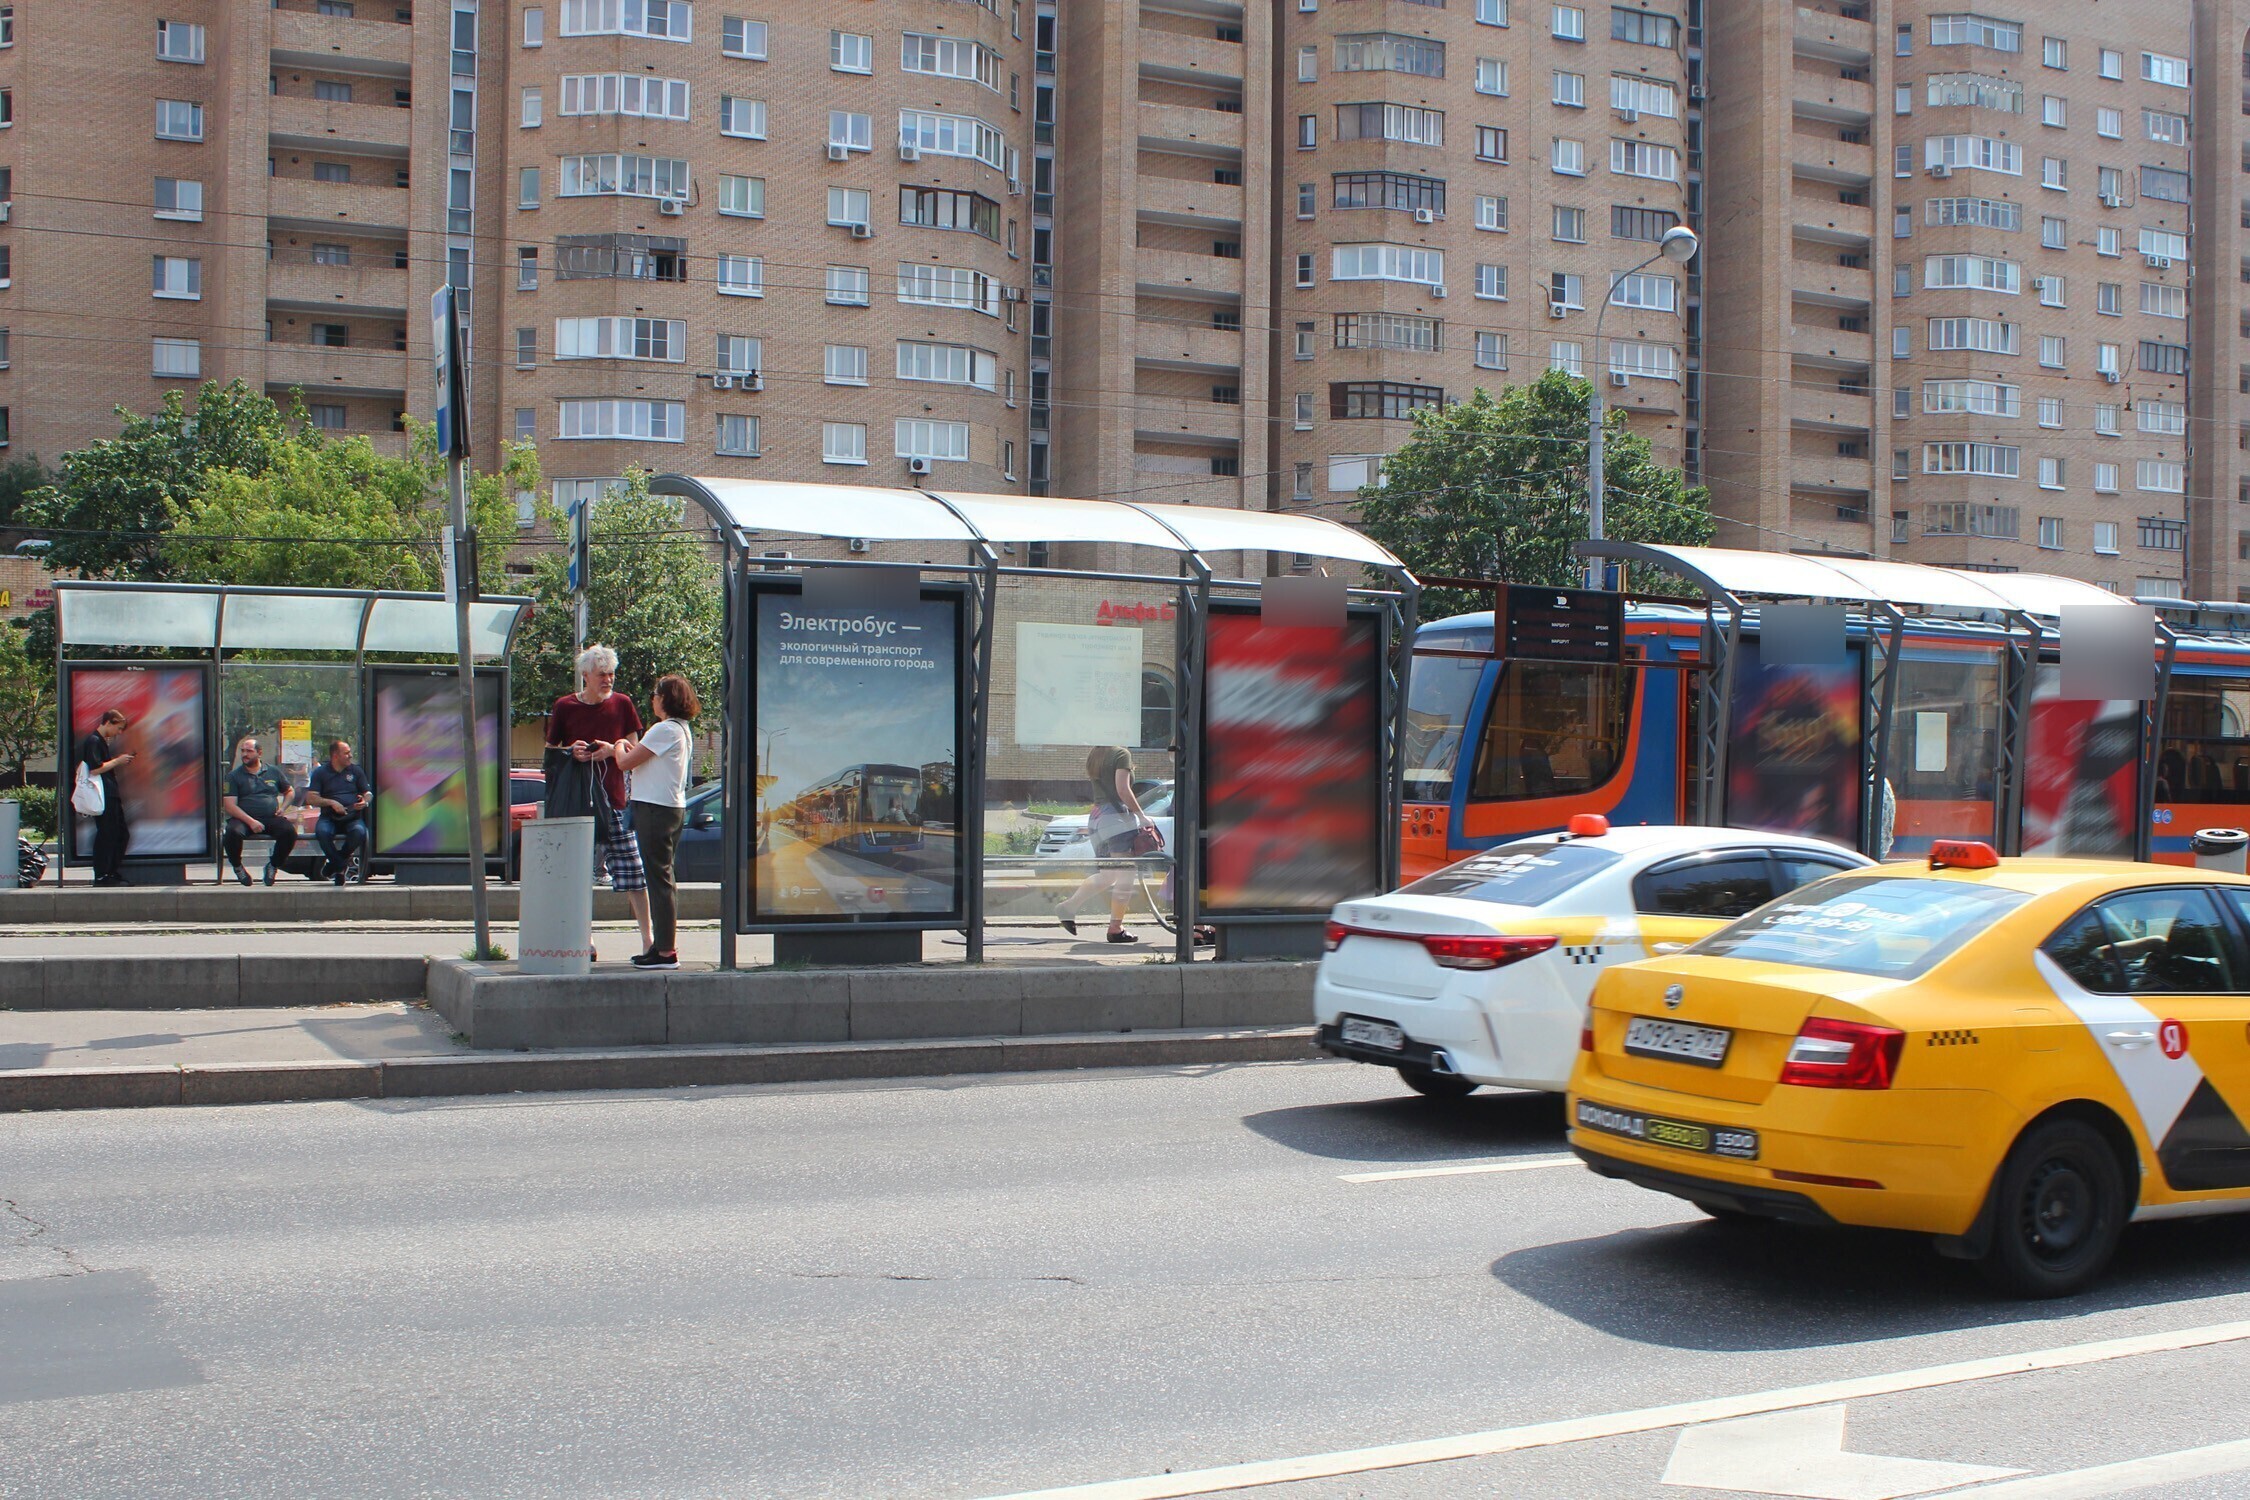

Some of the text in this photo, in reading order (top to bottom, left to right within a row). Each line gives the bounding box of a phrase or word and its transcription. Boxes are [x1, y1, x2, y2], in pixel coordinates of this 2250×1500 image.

[1097, 600, 1158, 625] Альфа
[779, 612, 897, 637] Электробус
[780, 642, 923, 655] экологичный транспорт
[779, 655, 935, 670] для современного города
[1715, 1132, 1755, 1148] 1500
